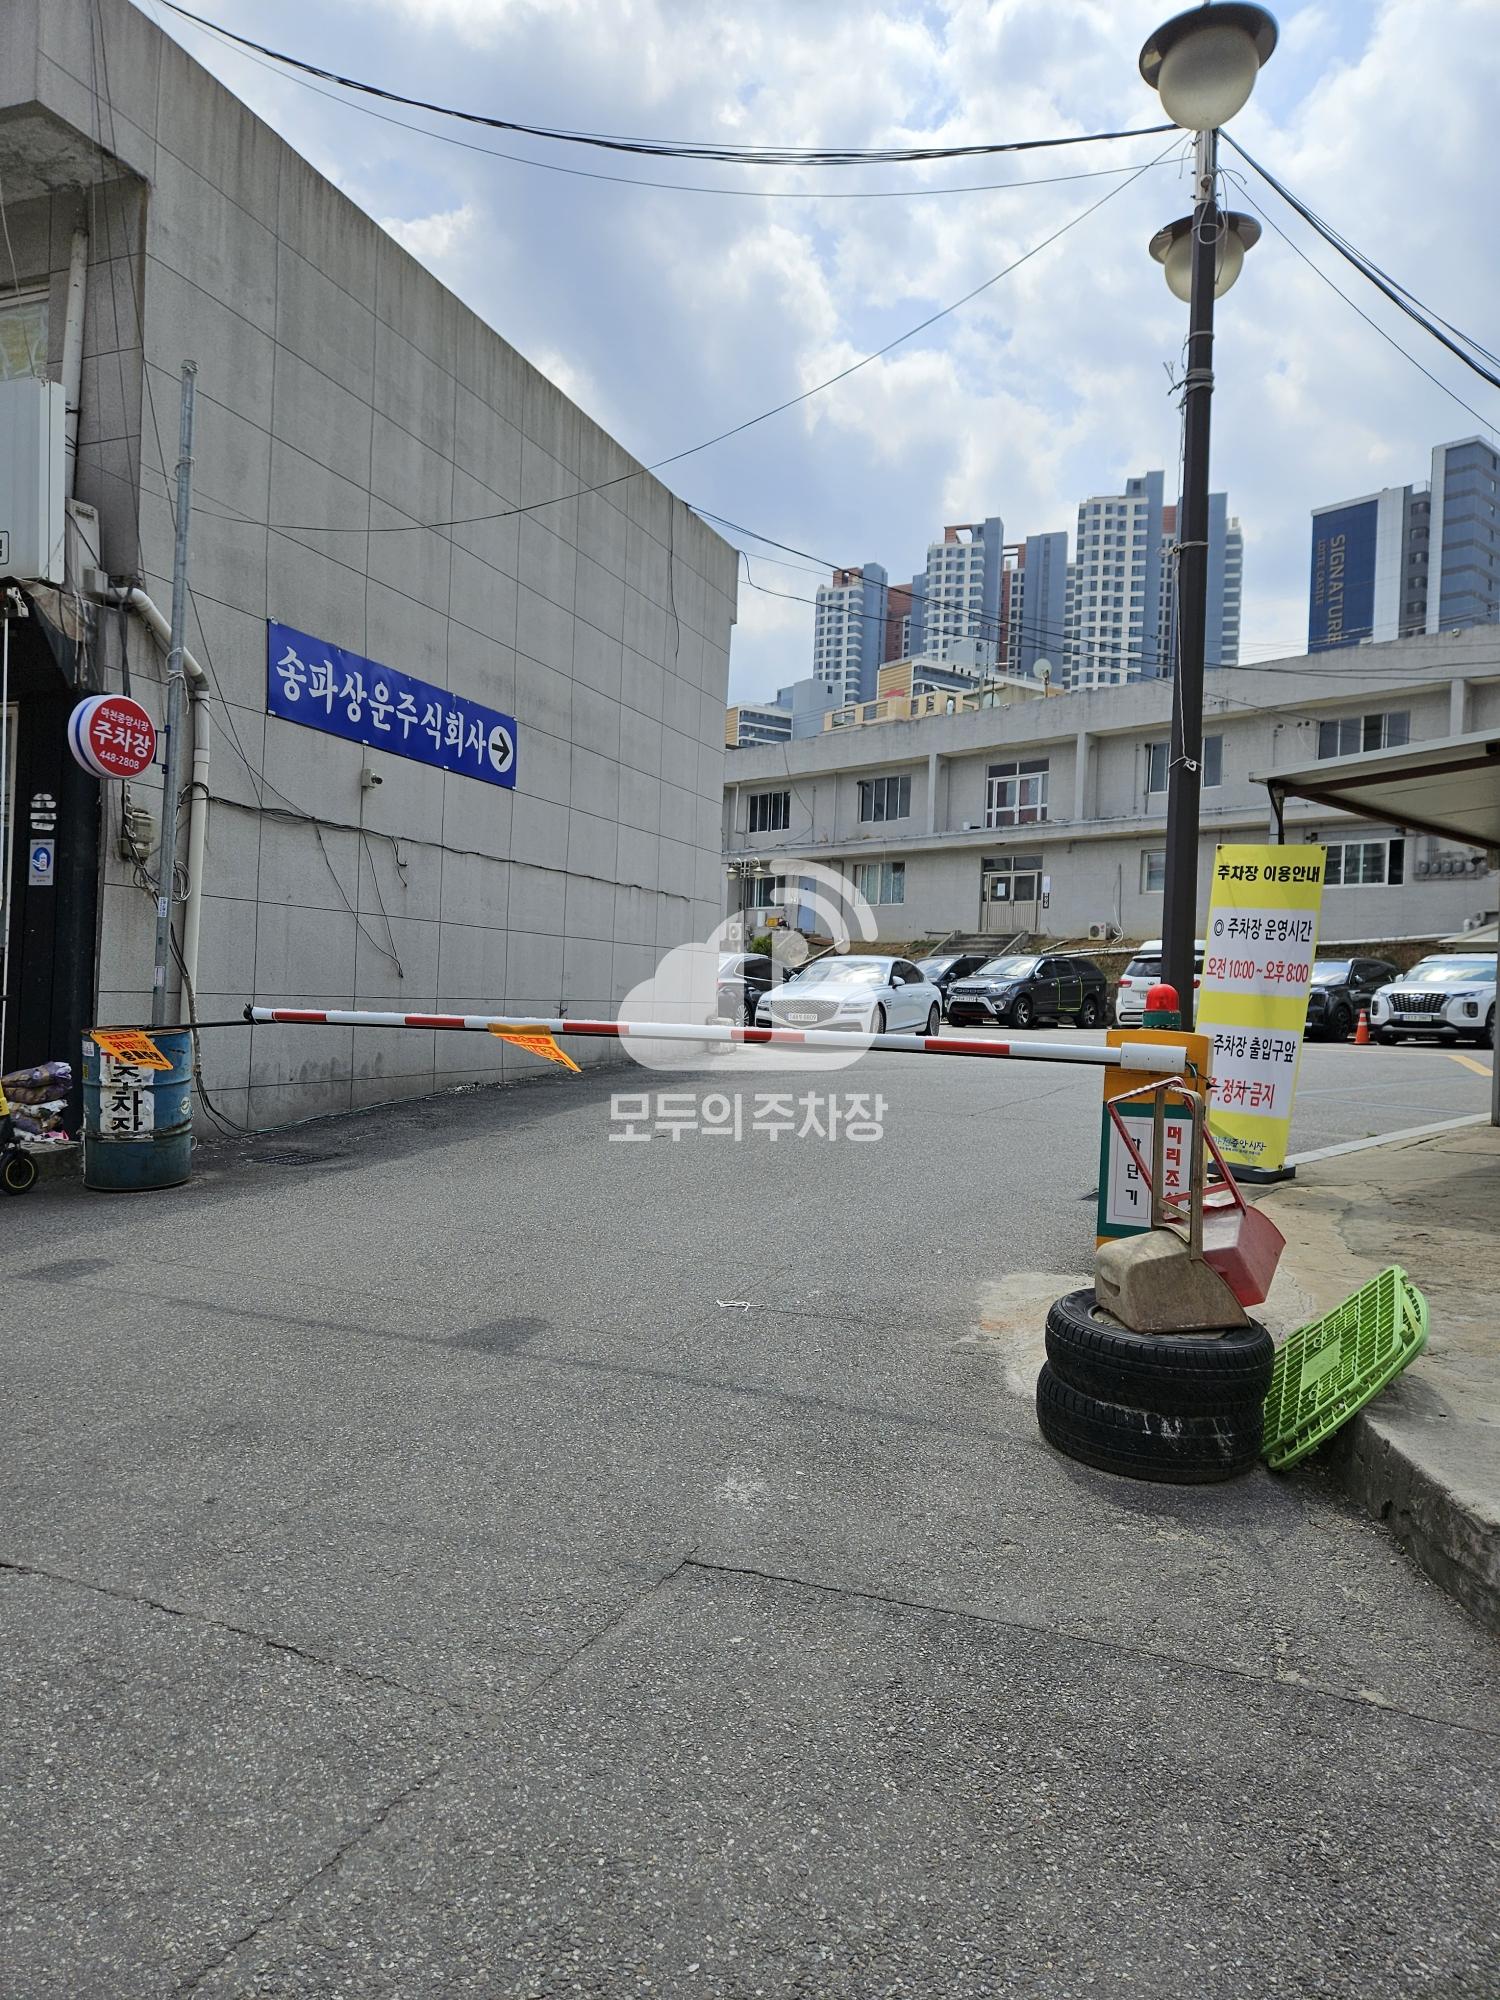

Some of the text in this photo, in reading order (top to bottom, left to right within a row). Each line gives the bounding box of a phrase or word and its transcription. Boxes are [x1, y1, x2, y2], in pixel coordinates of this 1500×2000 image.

[1328, 534, 1346, 644] SIGNATURE
[276, 646, 487, 764] 송파상운주식회사
[93, 720, 152, 757] 주차장
[99, 750, 140, 769] 448-2808
[1218, 865, 1320, 882] 주차장 이용안내
[1227, 918, 1312, 942] 주차장 운영시간
[1206, 958, 1227, 979] 오전
[1229, 960, 1255, 979] 10:00
[1264, 961, 1285, 983] 오후
[1286, 963, 1309, 983] 8:00
[1213, 1034, 1297, 1063] 주차장 출입구앞
[1249, 1082, 1276, 1110] 금지
[1164, 1126, 1182, 1199] 머리조
